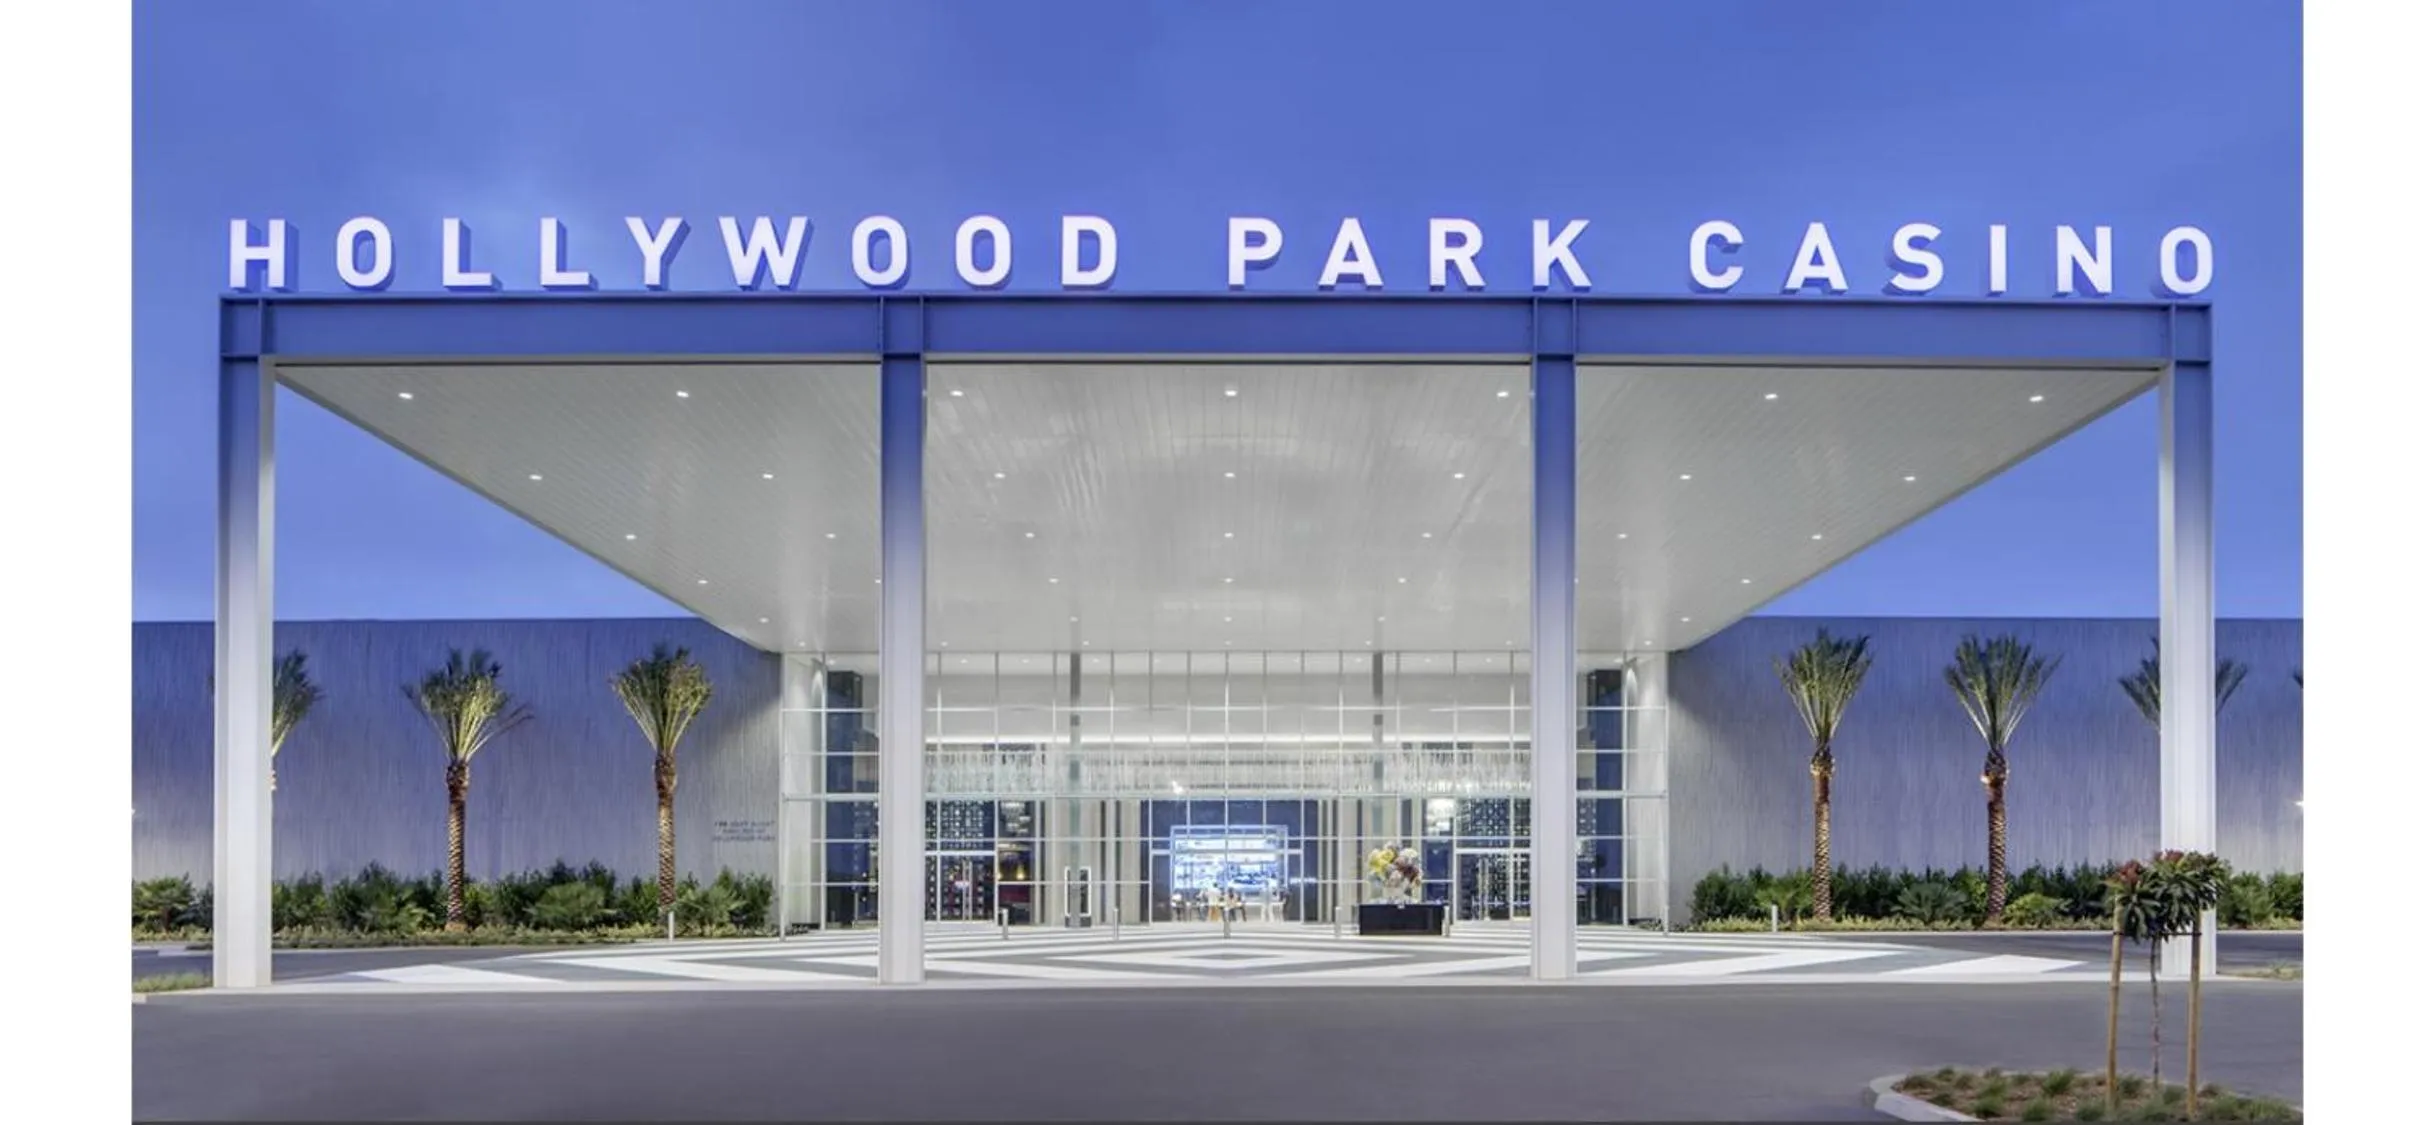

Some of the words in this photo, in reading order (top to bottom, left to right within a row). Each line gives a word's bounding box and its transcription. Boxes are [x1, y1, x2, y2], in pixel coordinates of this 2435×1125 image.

[230, 215, 1118, 288] HOLLYWOOD
[1228, 217, 1590, 288] PARK
[1690, 220, 2214, 294] CASINO
